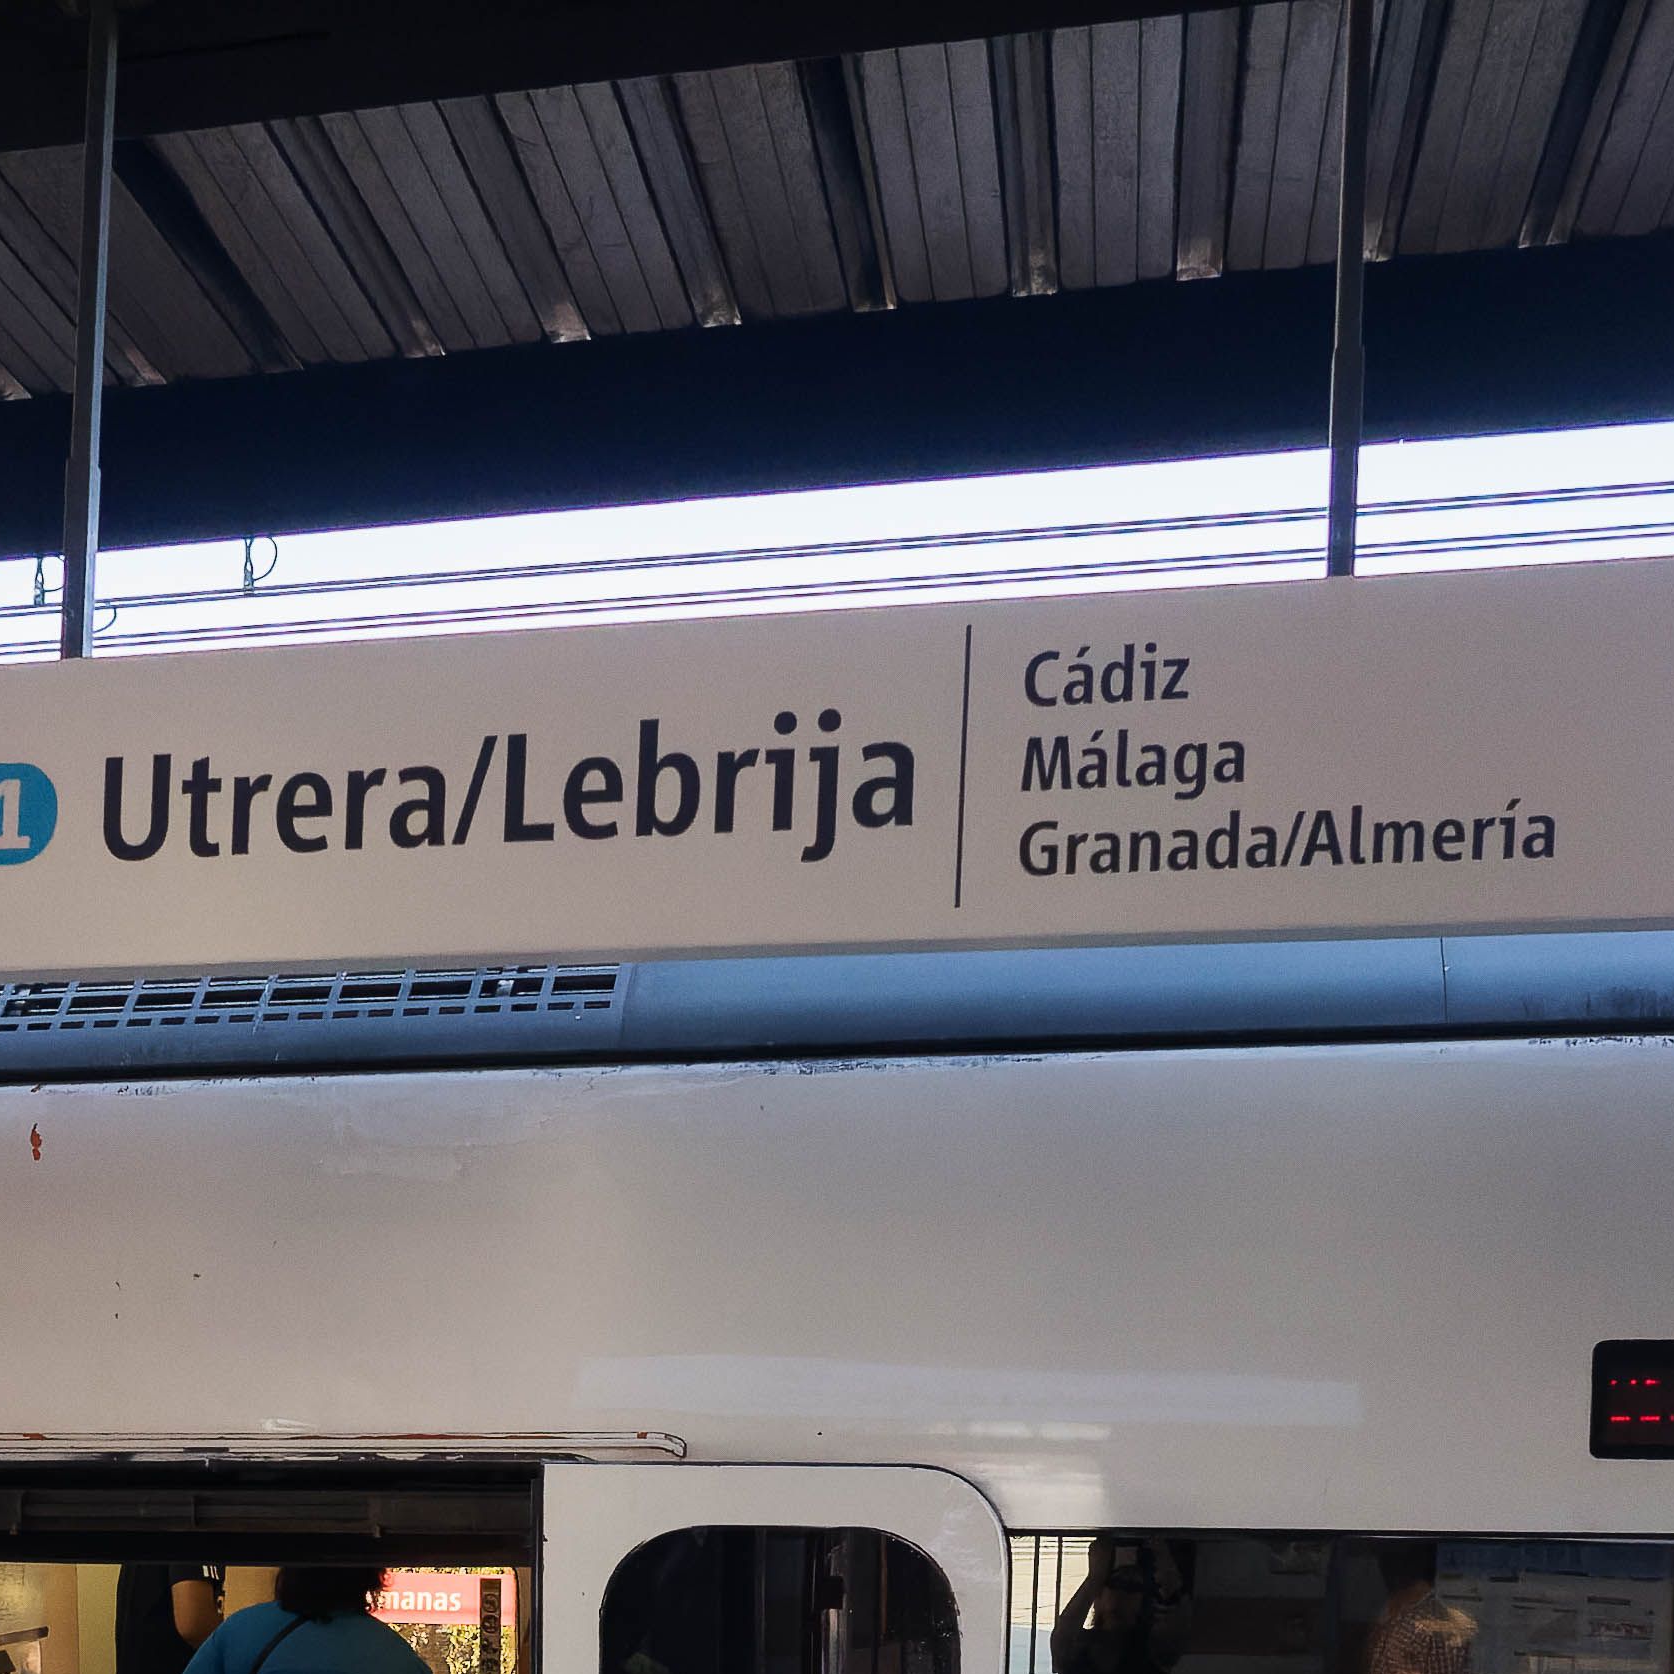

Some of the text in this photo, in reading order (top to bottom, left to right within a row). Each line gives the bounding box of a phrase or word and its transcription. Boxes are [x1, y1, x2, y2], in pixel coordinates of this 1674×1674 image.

[1024, 642, 1190, 708] Cádiz
[103, 708, 915, 863] Utrera/Lebrija
[1021, 729, 1246, 800] Málaga
[1019, 797, 1556, 877] Granada/Almería
